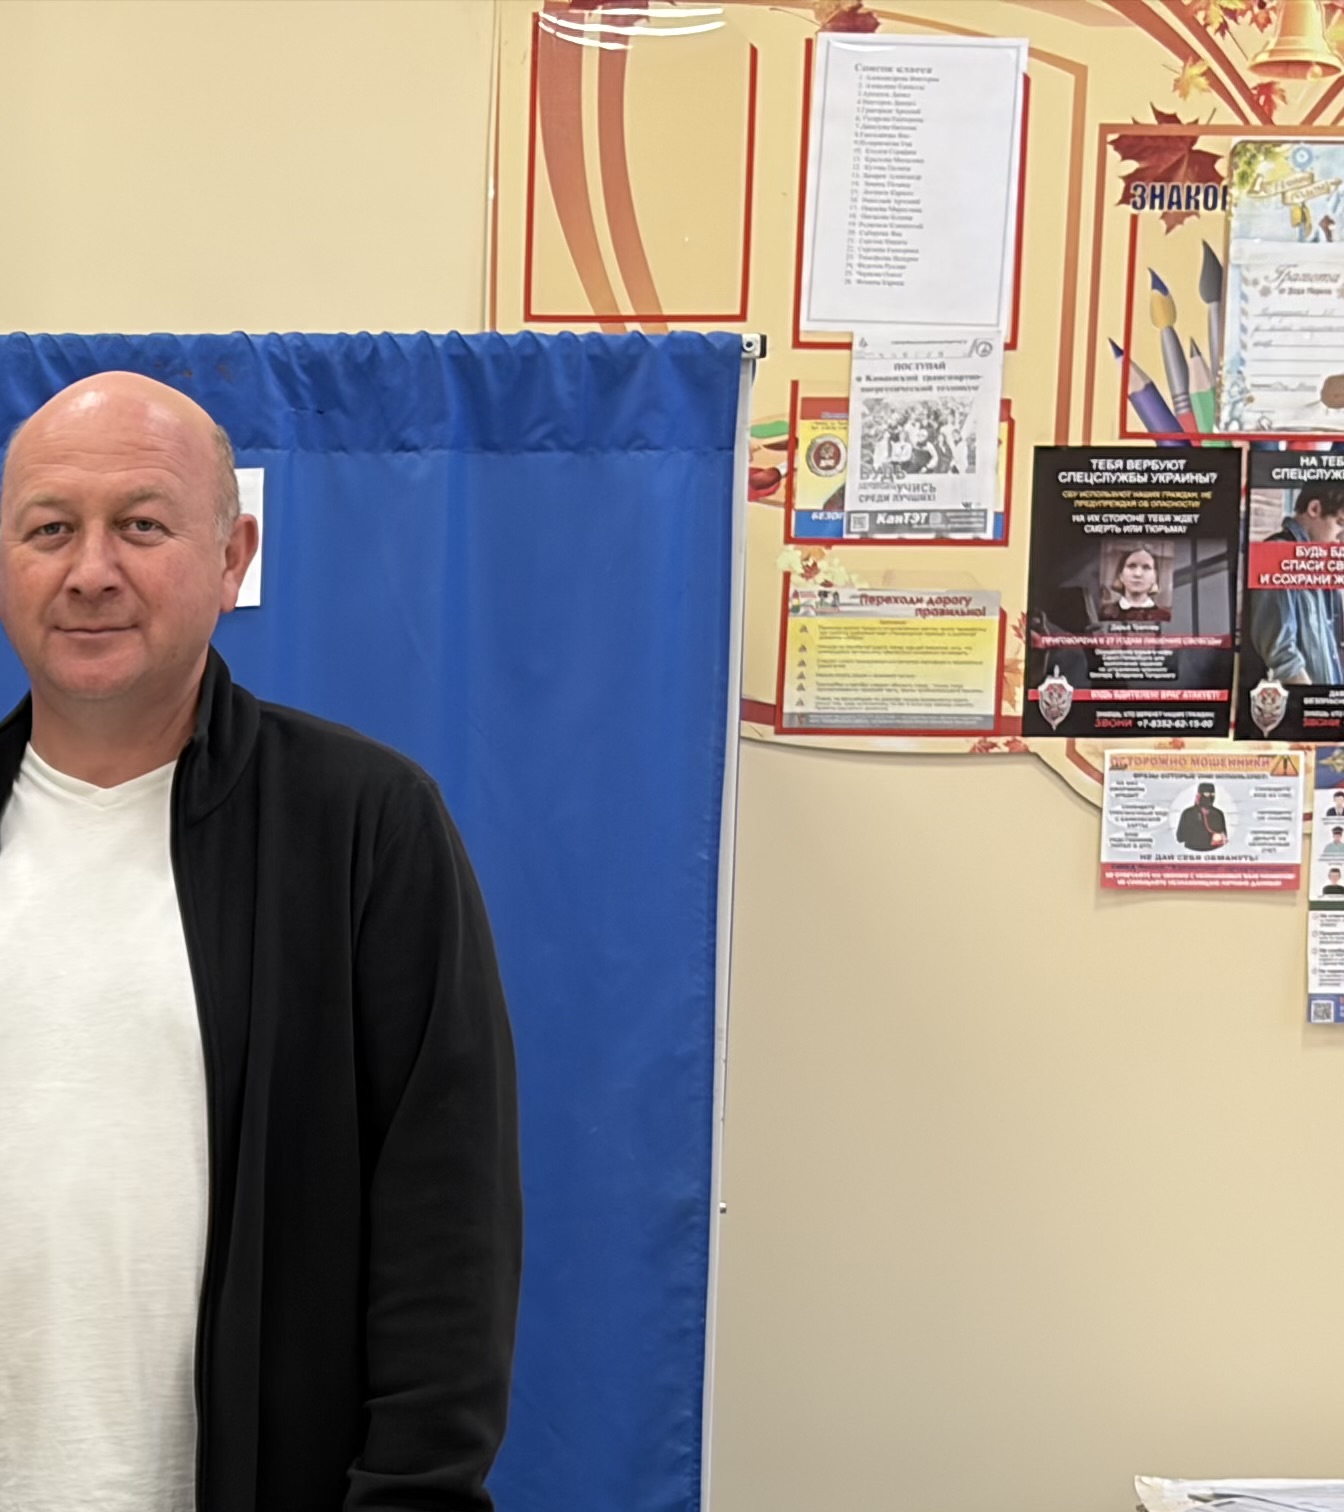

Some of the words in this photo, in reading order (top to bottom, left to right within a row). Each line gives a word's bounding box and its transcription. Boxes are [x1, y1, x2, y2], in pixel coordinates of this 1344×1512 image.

[1130, 183, 1229, 211] ЗНАКО
[893, 361, 946, 371] ПОСТУПАЙ
[1090, 458, 1123, 470] ТЕБЯ
[1126, 459, 1187, 470] ВЕРБУЮТ
[1299, 456, 1317, 467] НА
[1057, 471, 1149, 485] СПЕЦСЛУЖБЫ
[1150, 472, 1218, 485] УКРАИНЫ?
[876, 512, 928, 525] КанТЭТ
[1072, 514, 1085, 523] НА
[1087, 514, 1100, 523] ИХ
[1102, 514, 1145, 523] СТОРОНЕ
[1147, 514, 1171, 523] ТЕБЯ
[1173, 514, 1200, 523] ЖДЕТ
[1084, 525, 1122, 533] СМЕРТЬ
[1123, 525, 1143, 533] ИЛИ
[1295, 545, 1328, 559] БУДЬ
[1280, 560, 1325, 571] СПАСИ
[1259, 574, 1269, 584] И
[1272, 574, 1331, 585] СОХРАНИ
[859, 593, 923, 607] Переходи
[926, 595, 973, 607] дорогу
[915, 606, 986, 620] правильно!
[1110, 755, 1187, 767] ОСТОРОЖНО
[1191, 756, 1270, 768] МОШЕННИКИ
